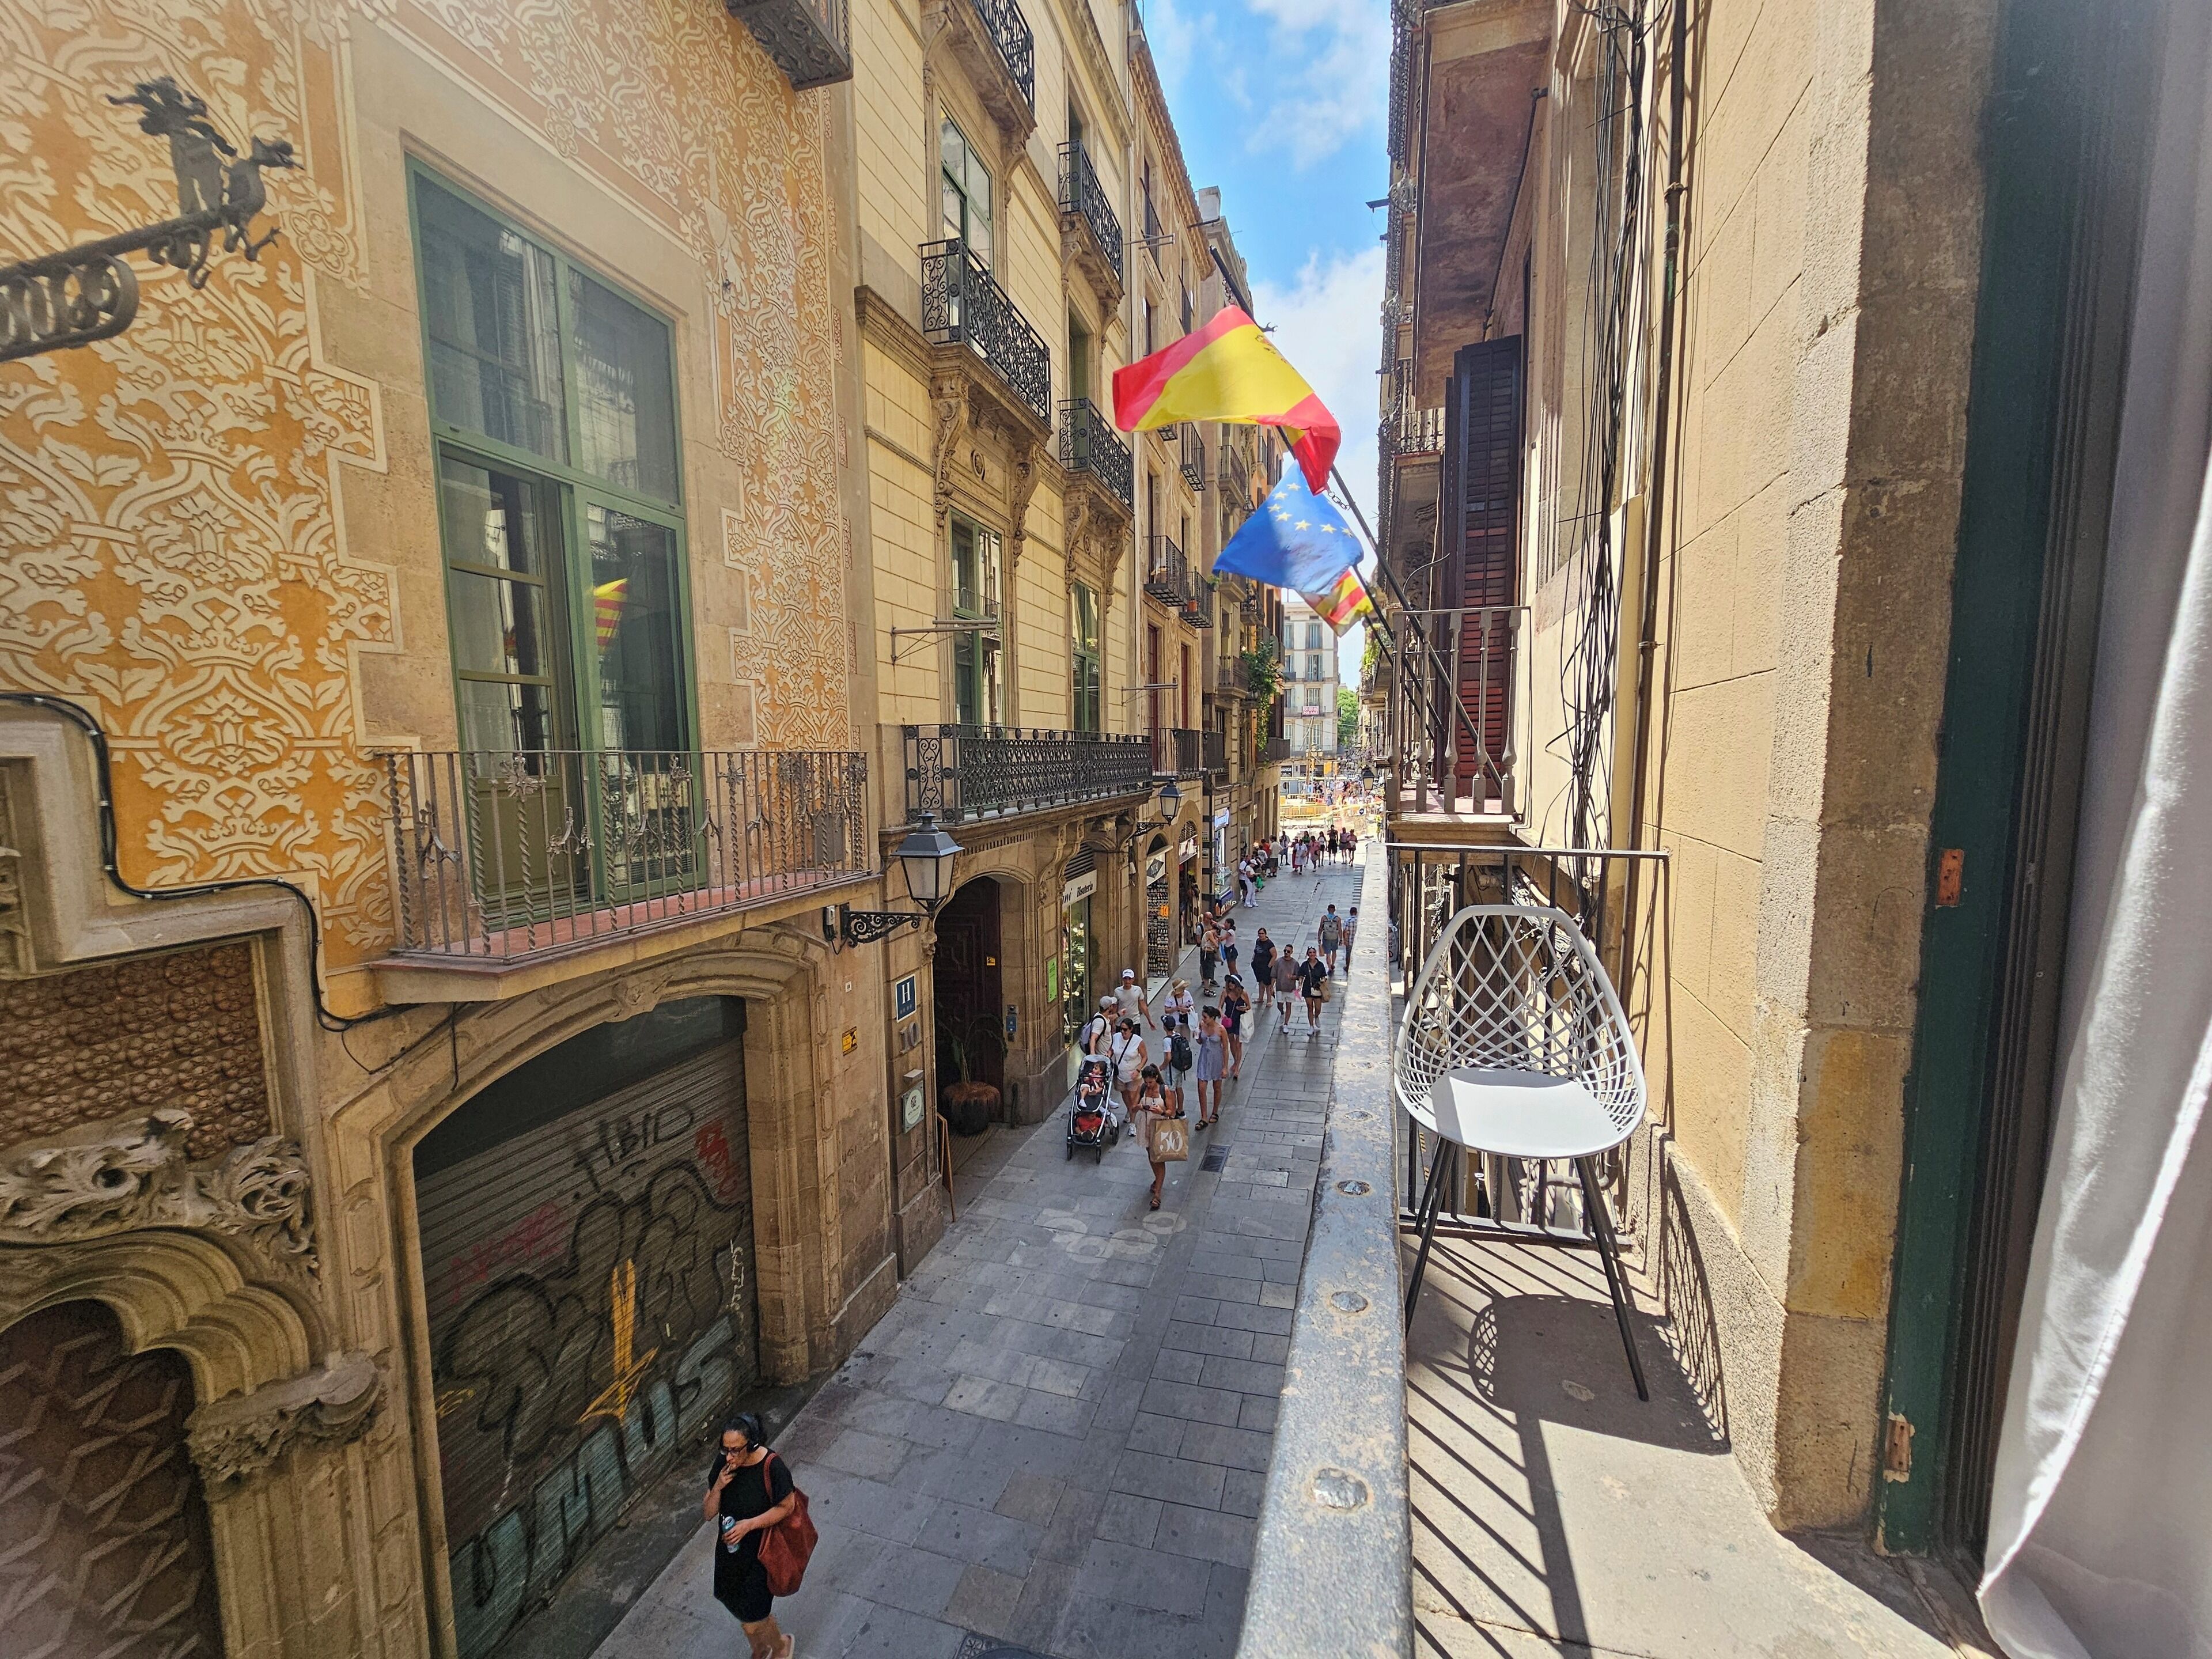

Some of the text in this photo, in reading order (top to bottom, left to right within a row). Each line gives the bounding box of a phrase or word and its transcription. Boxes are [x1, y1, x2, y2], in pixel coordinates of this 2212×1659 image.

[902, 982, 911, 1004] H
[899, 1022, 919, 1055] 10
[1160, 1130, 1183, 1152] 50
